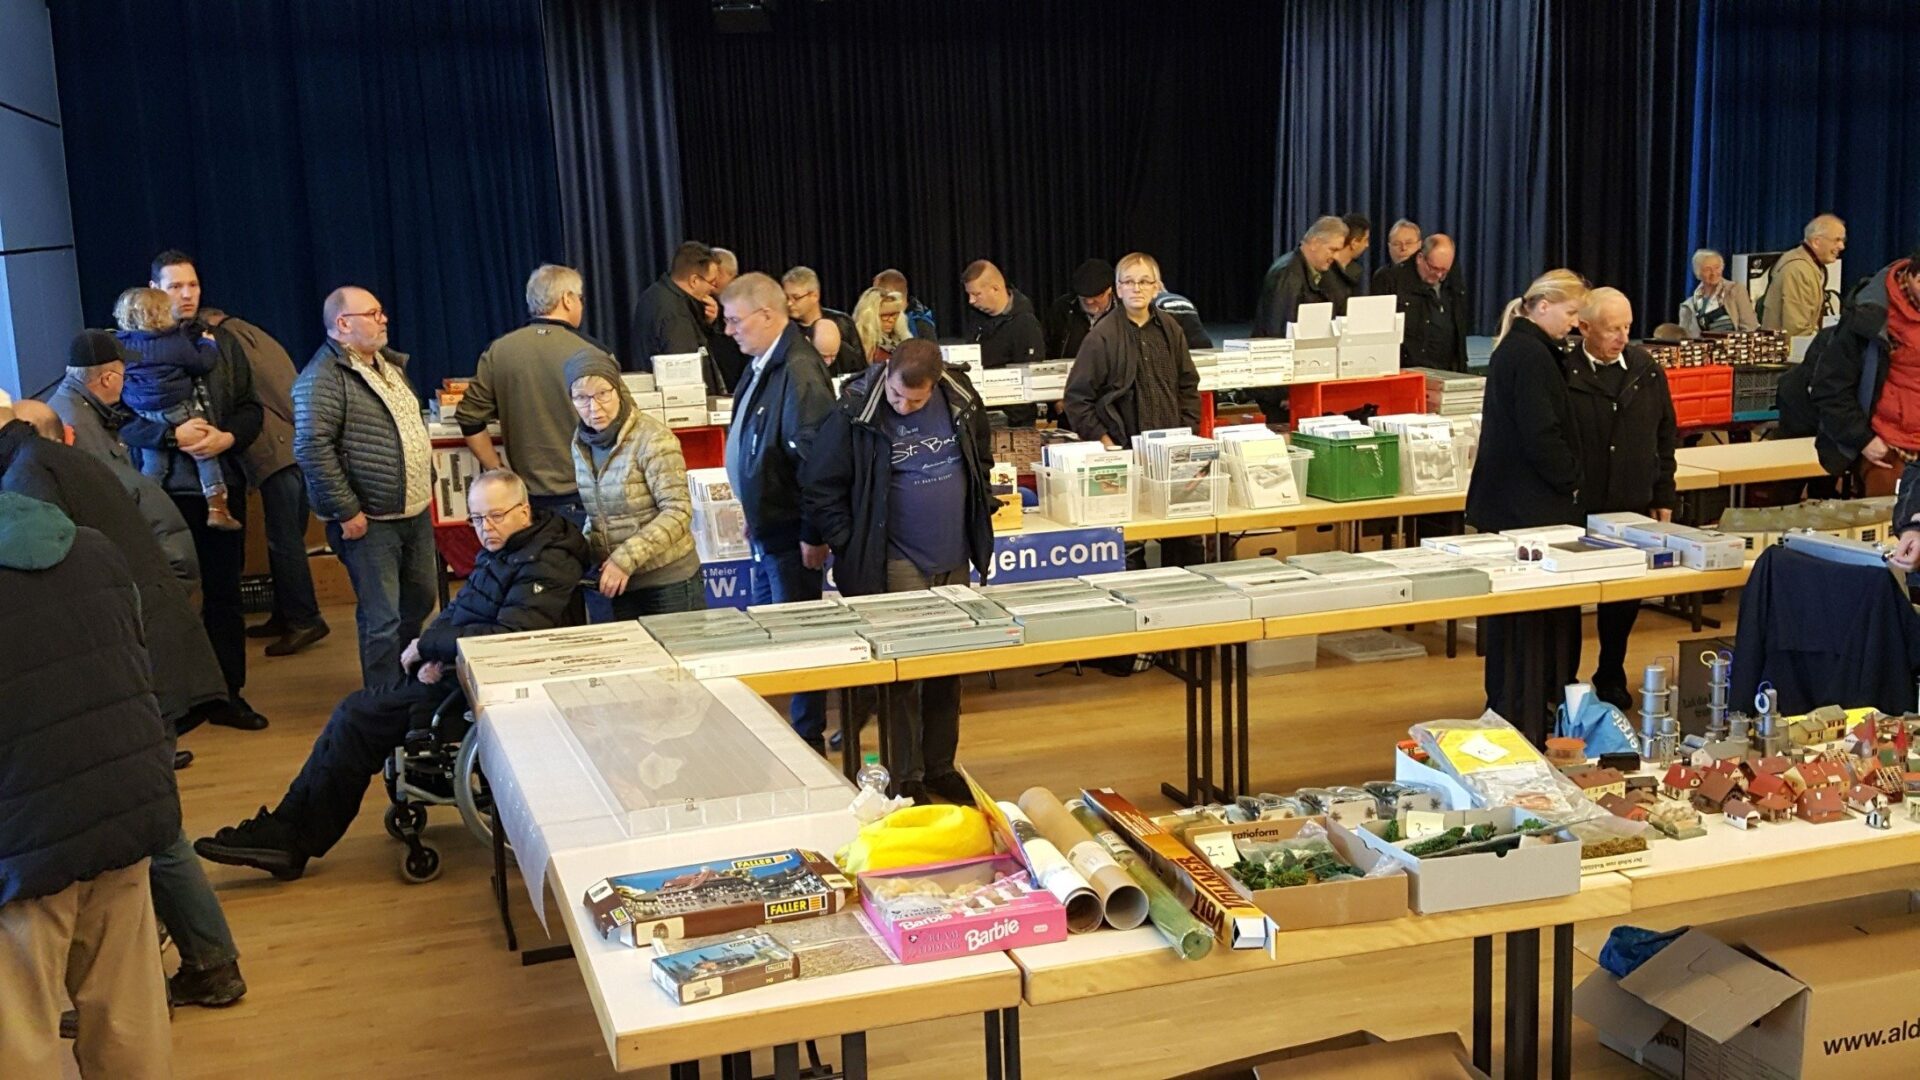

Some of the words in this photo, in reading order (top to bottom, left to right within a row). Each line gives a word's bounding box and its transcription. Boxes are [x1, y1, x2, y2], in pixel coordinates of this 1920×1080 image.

[709, 567, 738, 576] Meier
[1232, 828, 1279, 840] ratioform
[735, 858, 774, 869] FALLER
[1175, 855, 1254, 910] VOLLMER
[769, 899, 808, 916] FALLER
[899, 913, 953, 930] Barbie
[964, 918, 1020, 950] Barbie
[1823, 1016, 1920, 1056] www.ald
